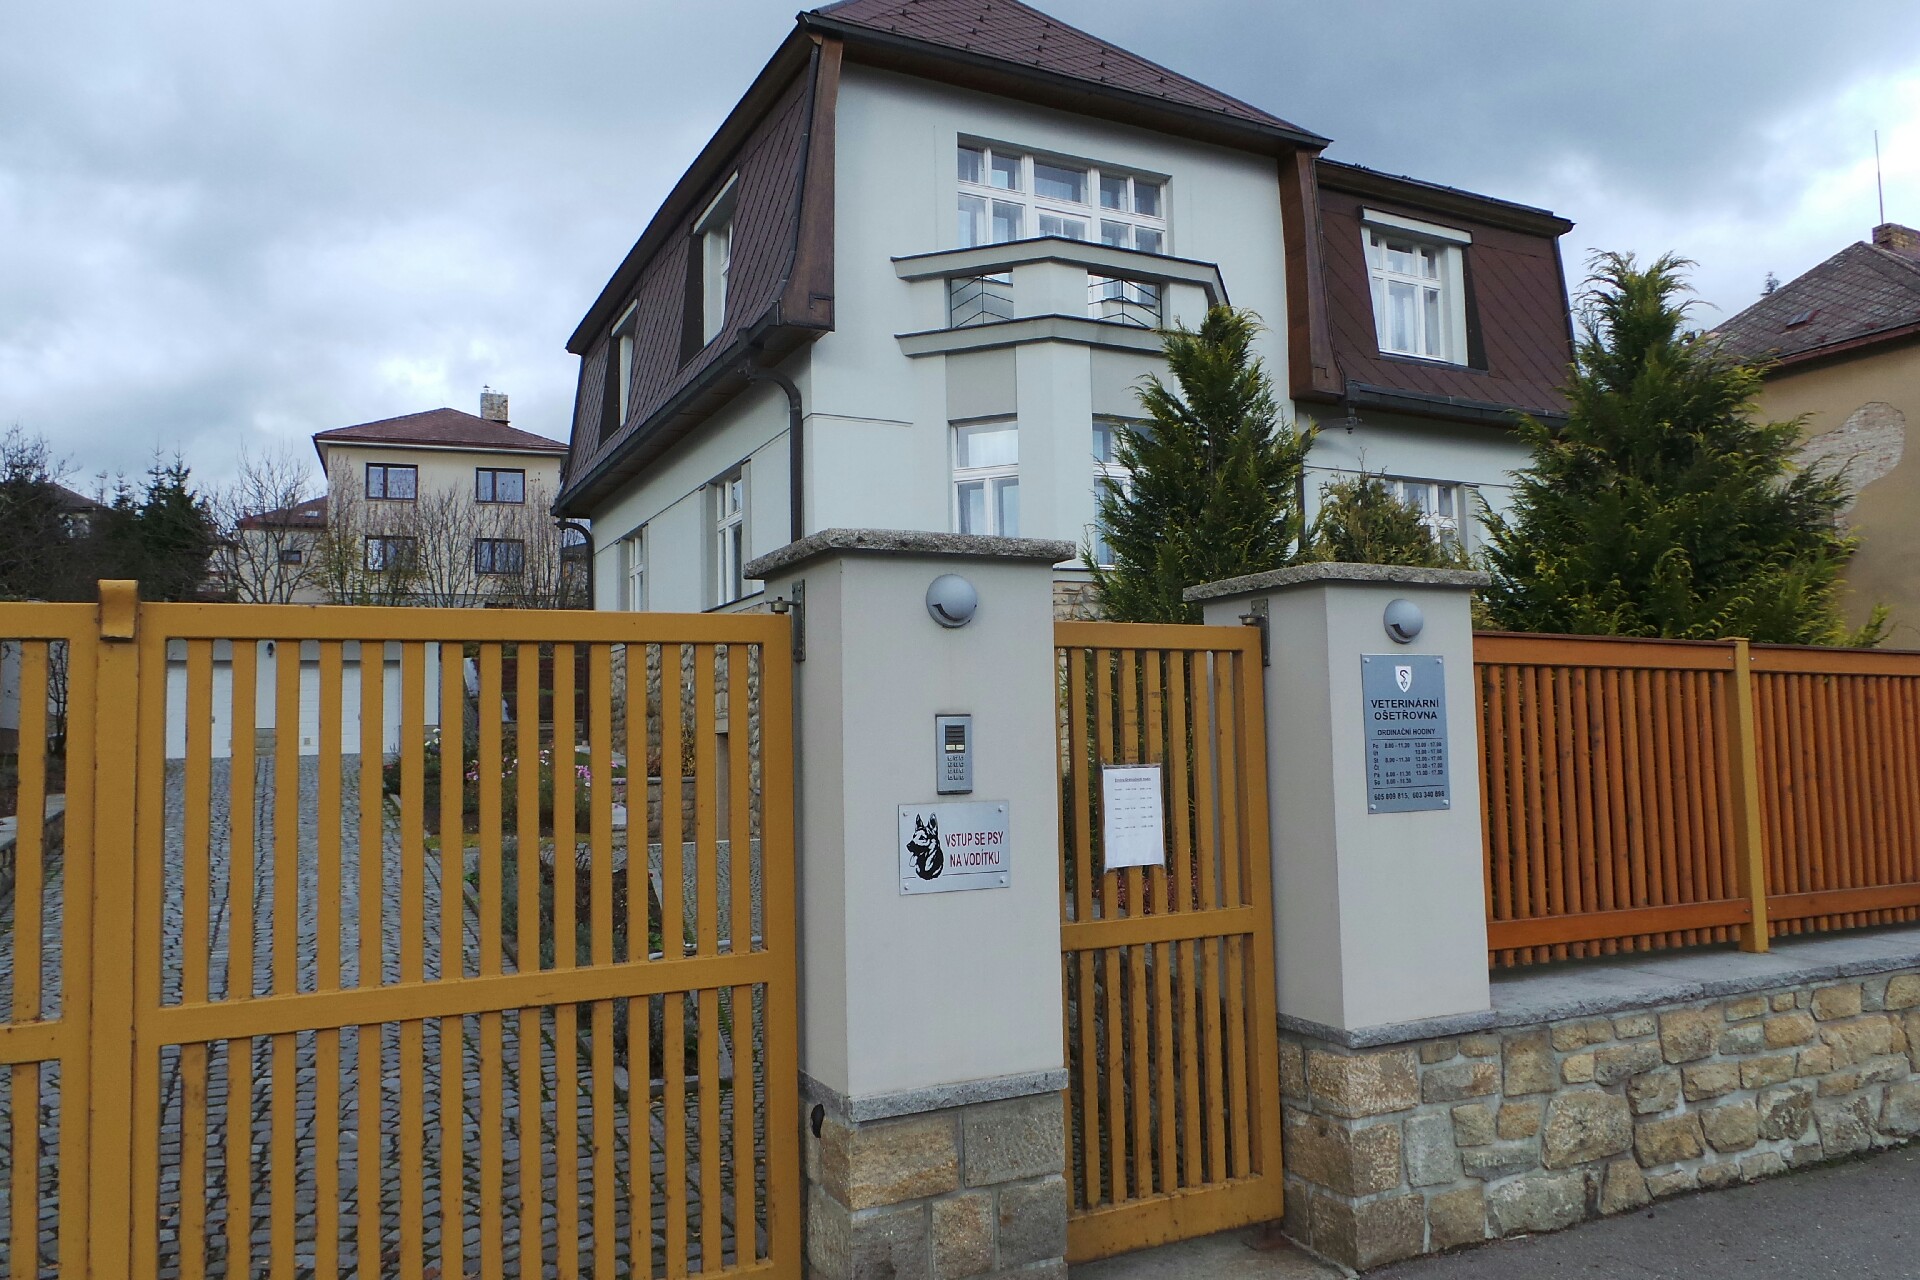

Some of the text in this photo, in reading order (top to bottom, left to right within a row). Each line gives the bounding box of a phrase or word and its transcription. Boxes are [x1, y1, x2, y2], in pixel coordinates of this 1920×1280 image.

[1371, 697, 1439, 708] VETERINÁRNÍ
[1374, 709, 1438, 720] OŠETŘOVNA
[1377, 728, 1412, 736] ORDINAČNÍ
[945, 831, 1004, 847] VSTUP SE PSY
[950, 849, 1000, 867] NA VODÍTKU
